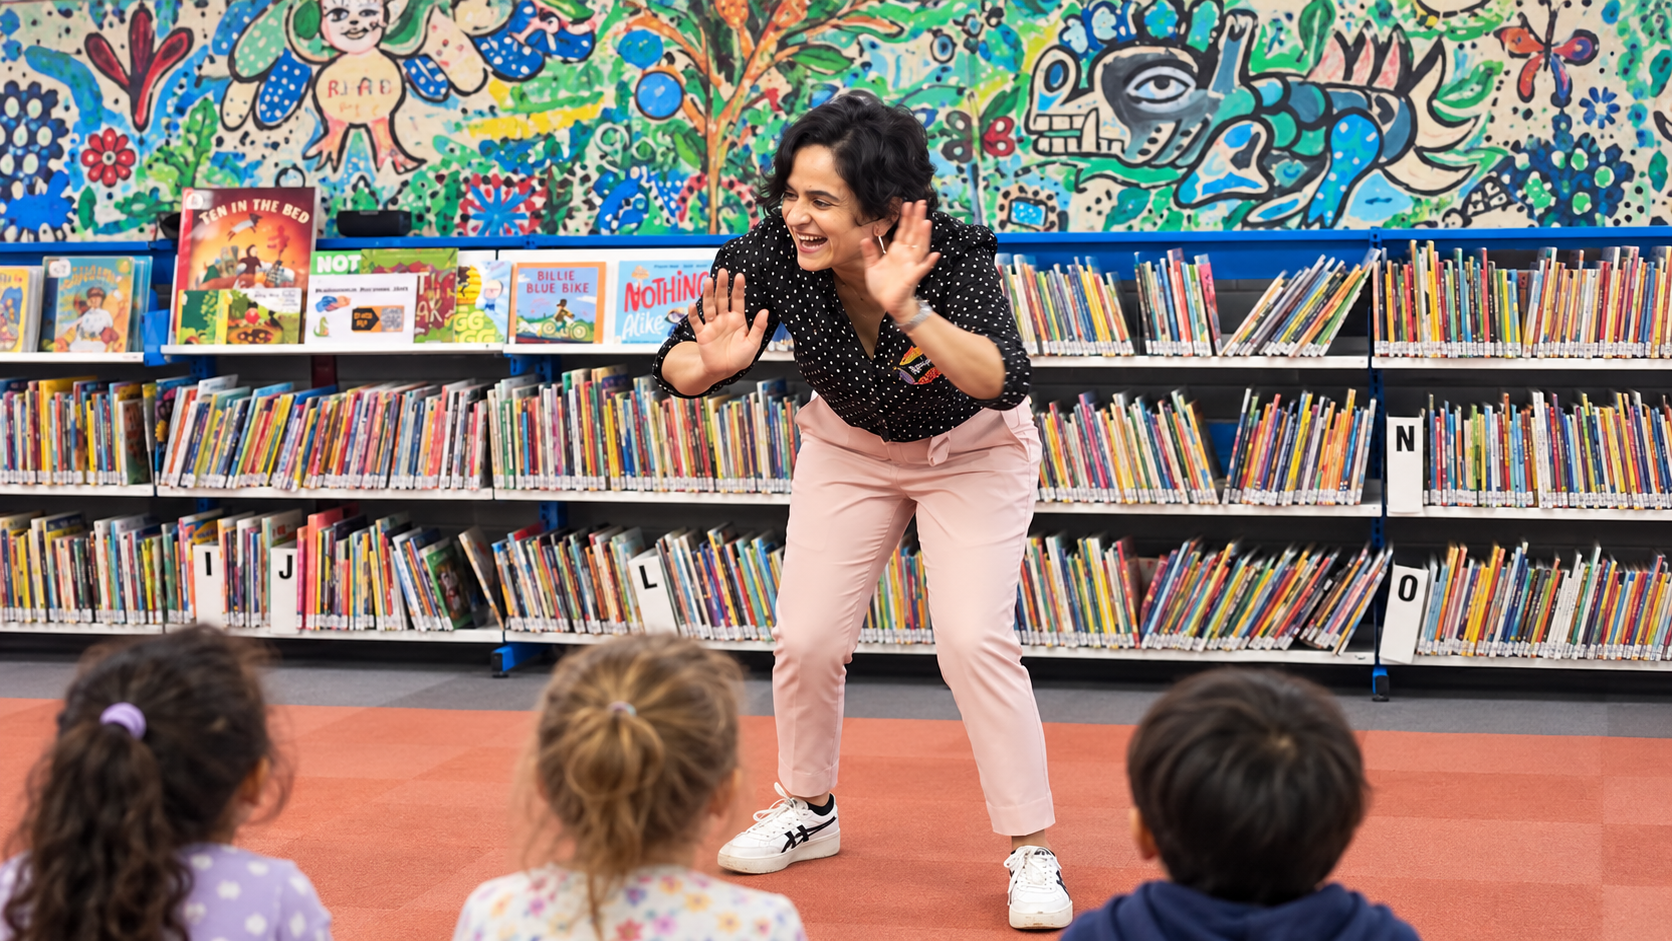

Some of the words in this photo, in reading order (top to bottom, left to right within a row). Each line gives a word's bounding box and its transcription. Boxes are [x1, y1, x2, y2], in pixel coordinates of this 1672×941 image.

[199, 205, 228, 225] TEN
[231, 200, 247, 213] IN
[253, 199, 279, 213] THE
[282, 203, 310, 224] BED
[317, 254, 361, 273] NOT
[537, 270, 575, 281] BILLIE
[526, 283, 556, 294] BLUE
[562, 282, 589, 293] BIKE
[621, 311, 665, 340] Alike
[1396, 425, 1415, 452] N
[205, 552, 212, 576] I
[279, 555, 293, 580] J
[639, 565, 657, 590] L
[1398, 574, 1418, 602] O
